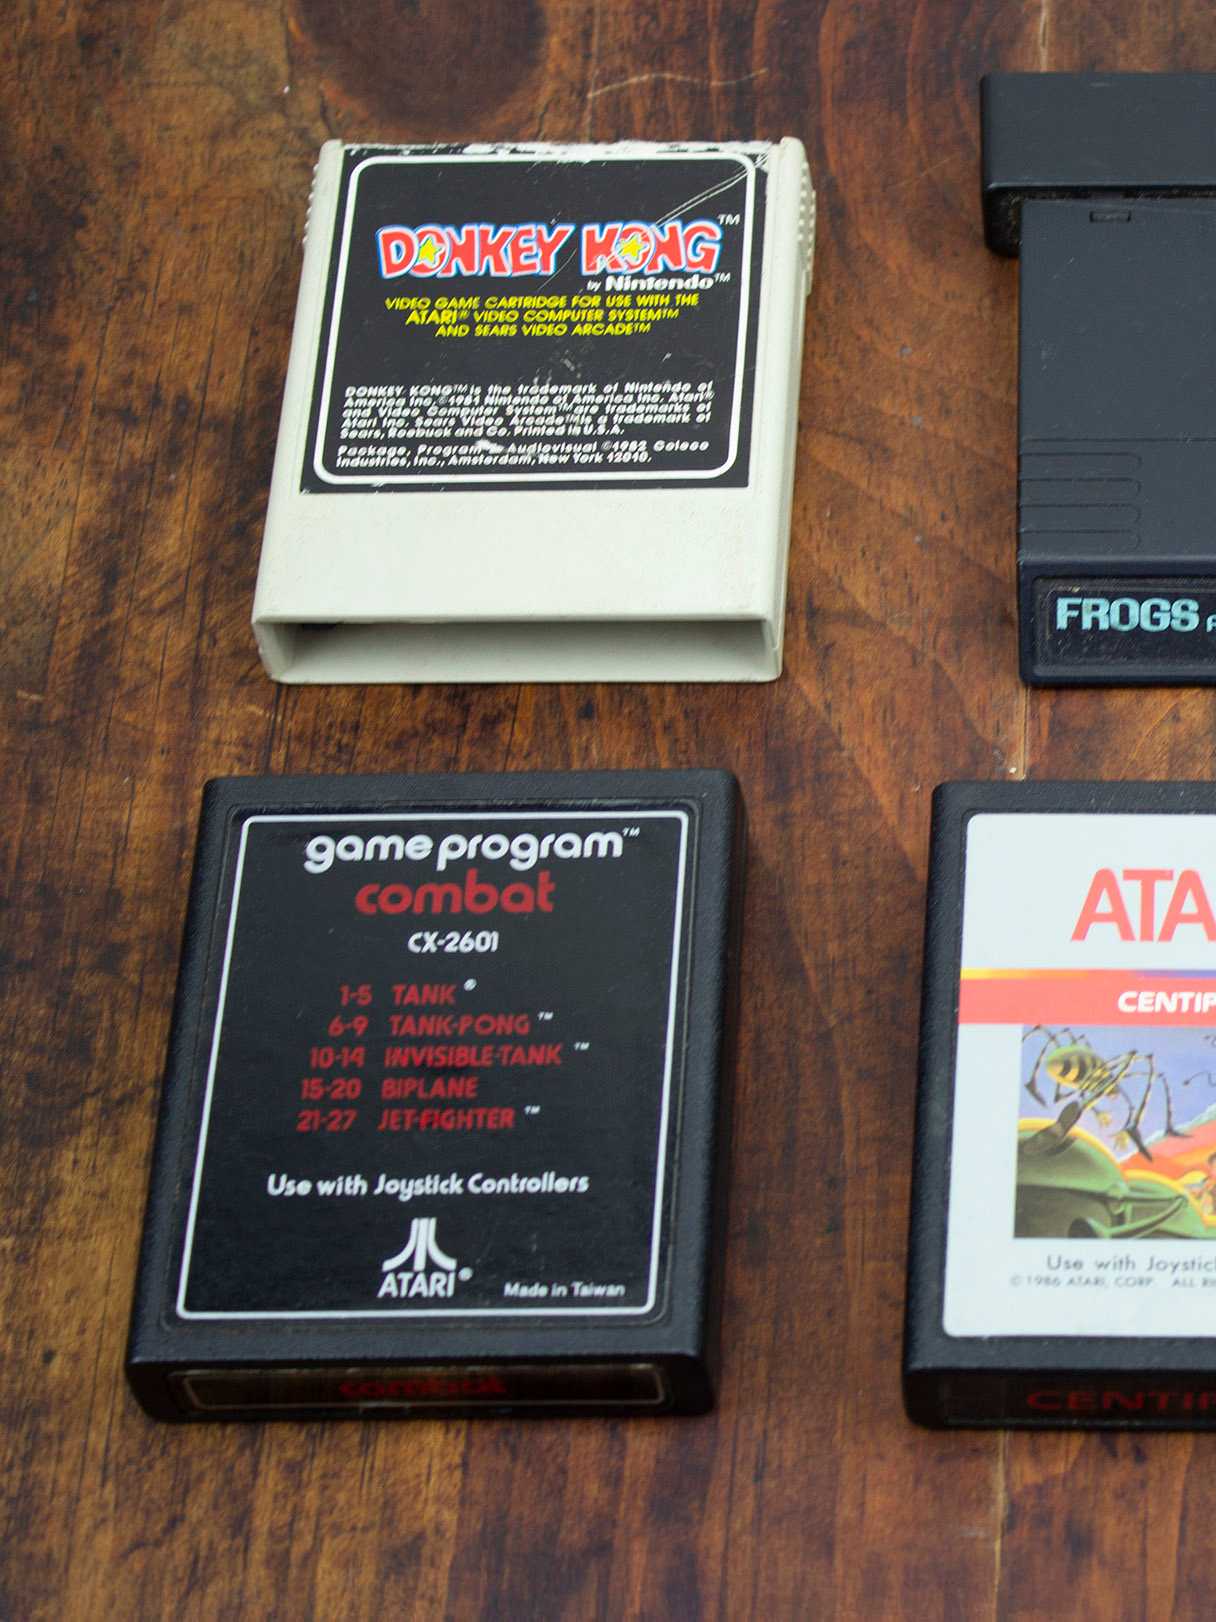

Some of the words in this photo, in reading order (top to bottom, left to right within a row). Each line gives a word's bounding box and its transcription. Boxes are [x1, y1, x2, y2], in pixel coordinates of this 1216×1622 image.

[375, 222, 576, 279] DONKEY
[587, 280, 601, 292] by
[385, 297, 430, 310] VIDEO
[435, 297, 480, 309] GAME
[485, 296, 567, 309] CARTRIDGE
[571, 295, 601, 307] FOR
[605, 294, 631, 307] USE
[637, 294, 670, 306] WITH
[676, 293, 699, 305] THE
[473, 310, 519, 323] VIDEO
[523, 309, 603, 322] COMPUTER
[435, 324, 470, 337] AND
[475, 324, 518, 337] SEARS
[521, 323, 567, 336] VIDEO
[345, 385, 404, 397] DONKEY
[488, 384, 512, 395] the
[518, 382, 597, 395] trademark
[603, 382, 619, 394] of
[624, 381, 691, 393] Nintendo
[697, 380, 714, 392] of
[344, 396, 406, 408] America
[484, 394, 551, 406] Nintendo
[553, 393, 568, 405] of
[572, 392, 632, 405] America
[342, 407, 372, 418] and
[378, 406, 420, 418] Video
[426, 405, 499, 418] Computer
[574, 404, 599, 415] are
[605, 402, 690, 415] trademarks
[696, 401, 712, 413] of
[341, 416, 377, 428] Atari
[414, 416, 456, 428] Sears
[461, 416, 504, 427] Video
[613, 413, 691, 424] trademark
[695, 412, 712, 423] of
[387, 427, 452, 439] Roebuck
[454, 427, 484, 438] and
[513, 424, 566, 438] Printed
[567, 424, 581, 436] in
[417, 444, 482, 457] Program
[506, 441, 598, 454] Audiovisual
[653, 440, 709, 452] Coleco
[538, 453, 570, 464] New
[573, 452, 603, 464] York
[1056, 597, 1200, 632] FROGS
[303, 833, 433, 874] game
[355, 868, 557, 916] combat
[407, 930, 500, 954] CX-2601
[340, 984, 373, 1006] 1-5
[328, 1015, 368, 1037] 6-9
[310, 1047, 365, 1069] 10-14
[300, 1078, 361, 1100] 15-20
[380, 1076, 480, 1099] BIPLANE
[296, 1109, 357, 1132] 21-27
[267, 1174, 312, 1196] Use
[317, 1174, 368, 1196] with
[373, 1173, 464, 1202] Joystick
[468, 1171, 590, 1194] Controllers
[1047, 1255, 1083, 1270] Use
[1095, 1255, 1136, 1270] with
[504, 1282, 547, 1297] Made
[551, 1282, 568, 1297] in
[571, 1281, 625, 1297] Taiwan
